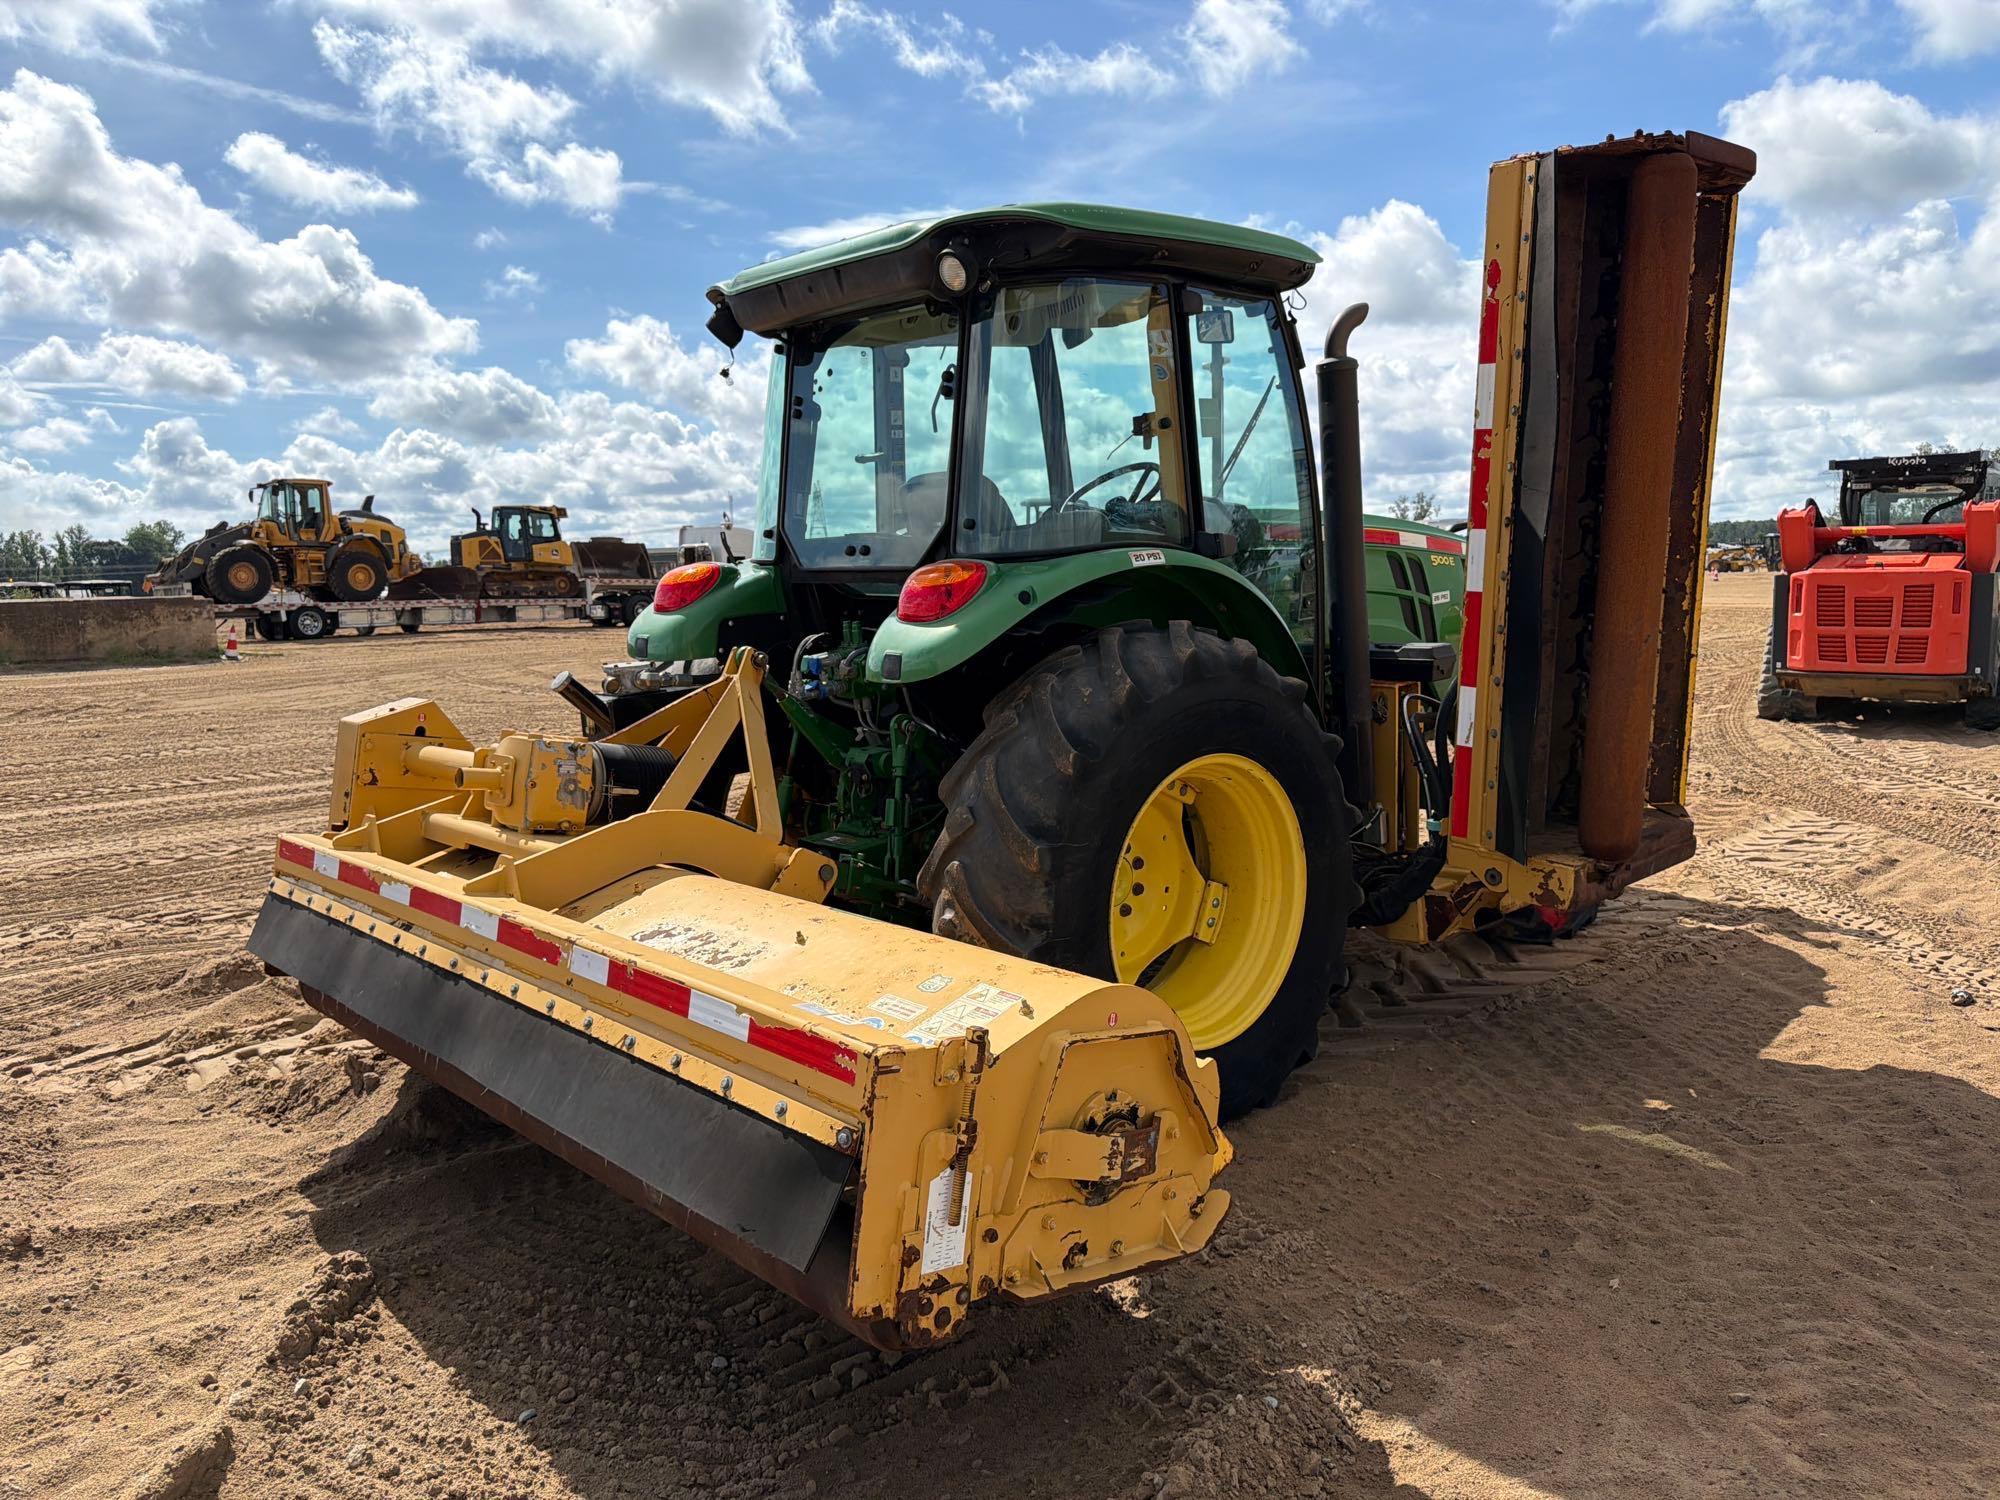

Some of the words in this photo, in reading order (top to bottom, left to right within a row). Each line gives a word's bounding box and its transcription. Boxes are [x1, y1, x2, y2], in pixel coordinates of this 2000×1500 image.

[1888, 456, 1927, 466] Kubota
[1133, 553, 1145, 562] 20
[1146, 552, 1162, 561] PSI
